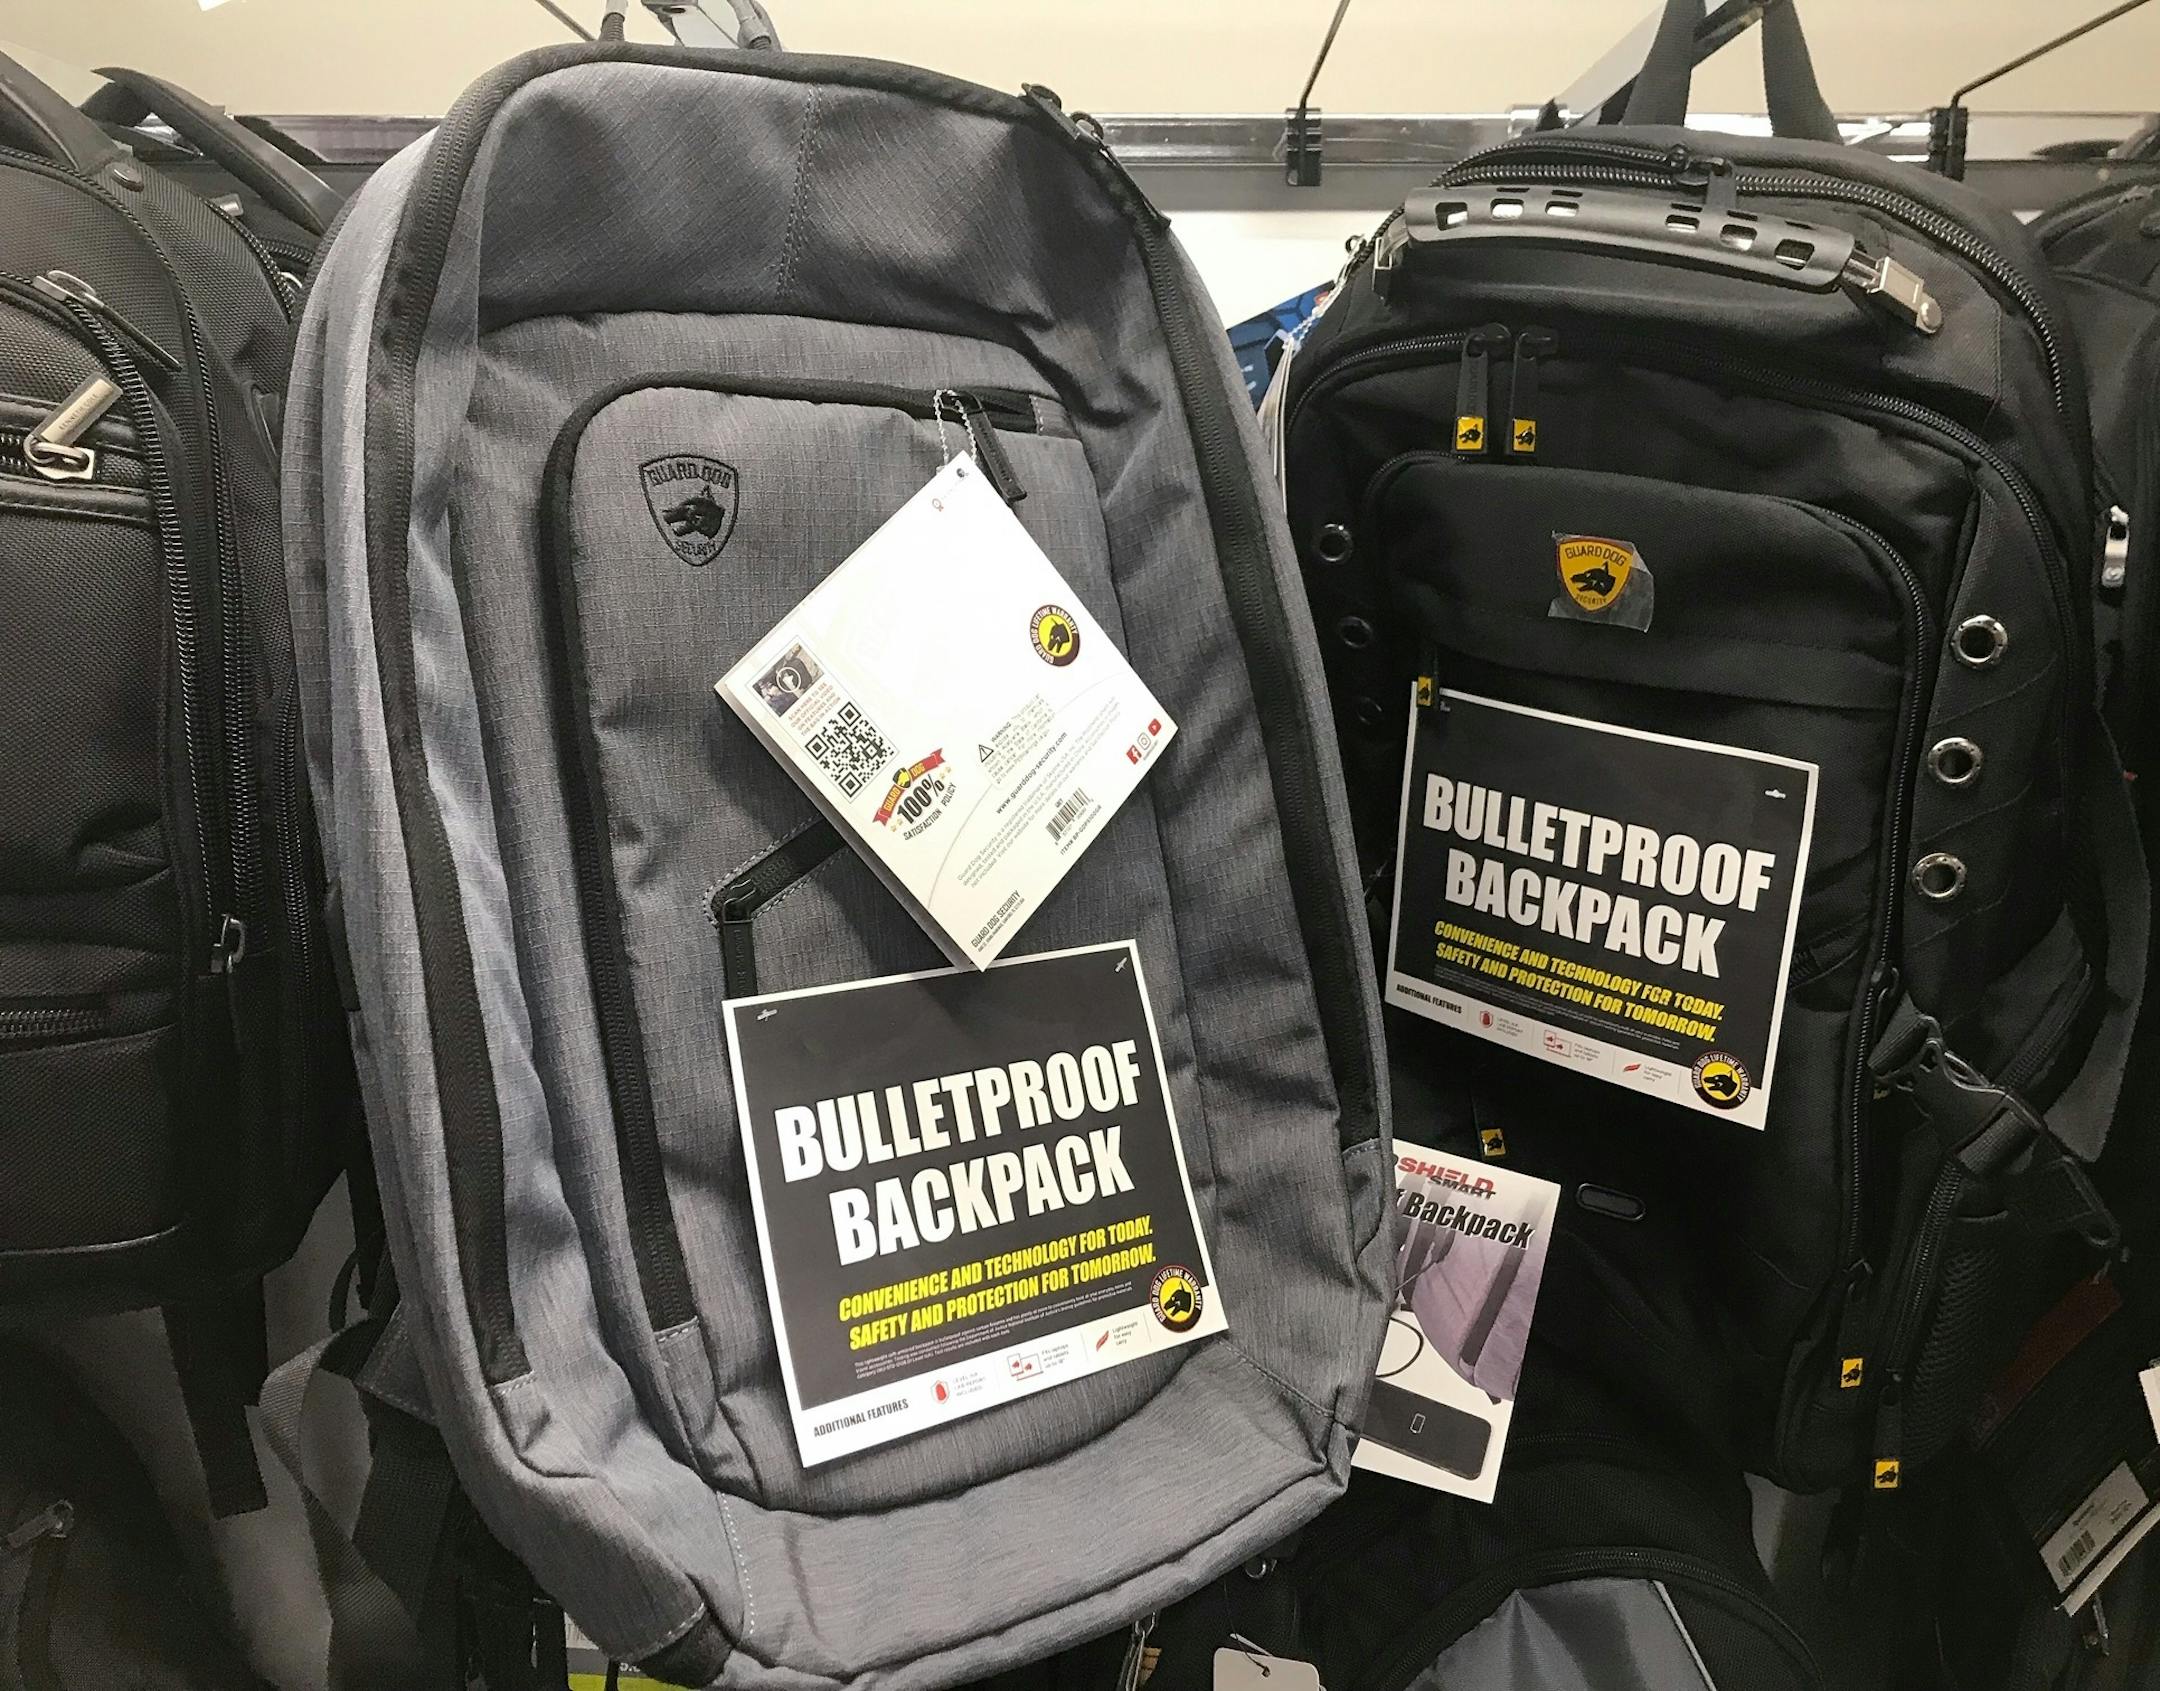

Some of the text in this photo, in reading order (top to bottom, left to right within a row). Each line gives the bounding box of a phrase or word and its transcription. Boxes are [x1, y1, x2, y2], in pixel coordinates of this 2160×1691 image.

[647, 463, 698, 486] GUARD
[1565, 545, 1627, 566] GUARD DOG
[882, 762, 926, 812] GUARD DOG
[893, 773, 946, 823] 100%
[994, 730, 1069, 814] www.guarddog-security.com
[902, 782, 956, 840] SATISFACTION POLICY
[1423, 773, 1776, 912] BULLETPROOF
[970, 925, 990, 947] GUARD
[986, 914, 999, 929] DOG
[995, 889, 1020, 917] SECURITY
[1445, 848, 1726, 978] BACKPACK
[1395, 983, 1463, 1014] ADDITIONAL FEATURES
[1434, 920, 1725, 1021] CONVENIENCE AND TECHNOLOGY FOR TODAY.
[1435, 942, 1717, 1042] SAFETY AND PROTECTION FOR TOMORROW.
[774, 1039, 1141, 1183] BULLETPROOF
[829, 1126, 1134, 1266] BACKPACK
[1430, 1176, 1496, 1200] SMART
[1403, 1192, 1535, 1249] Backpack
[840, 1214, 1153, 1322] CONVENIENCE AND TECHNOLOGY FOR TODAY.
[849, 1242, 1156, 1351] SAFETY AND PROTECTION FOR TOMORROW.
[812, 1397, 909, 1437] ADDITIONAL FEATURES
